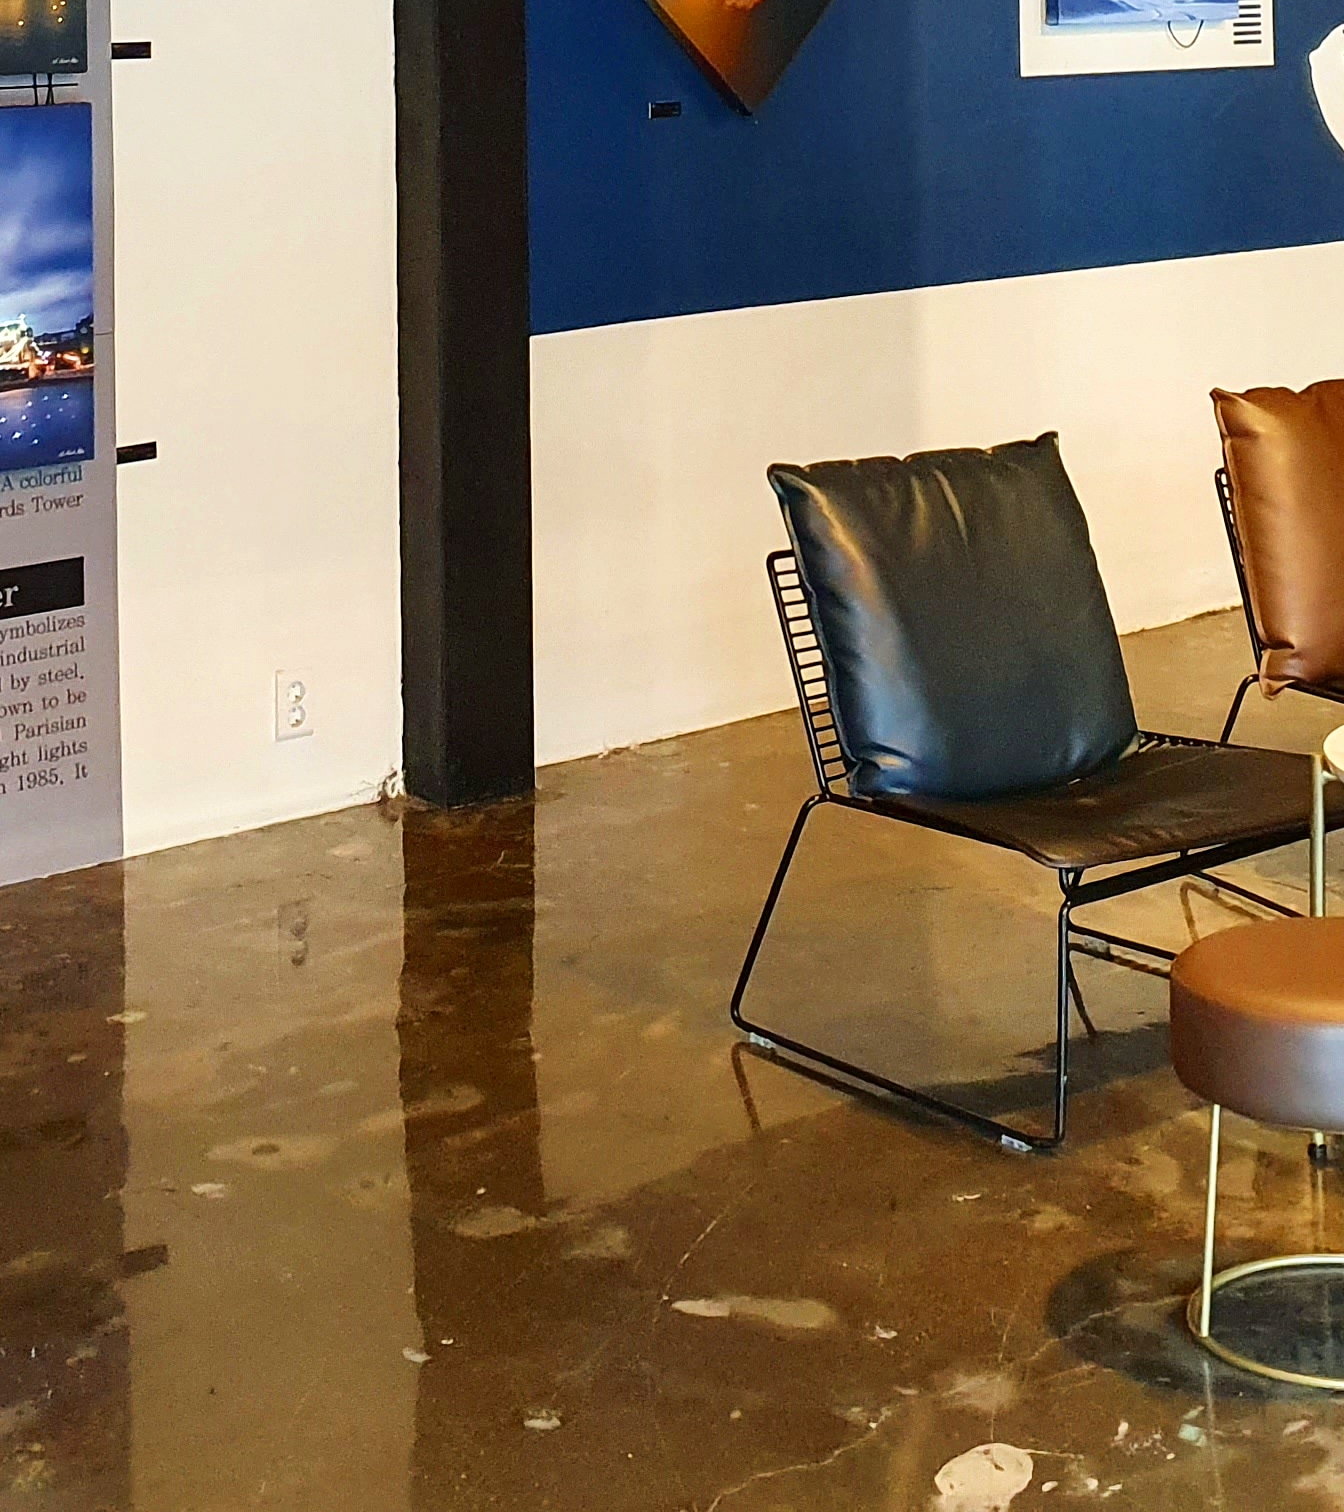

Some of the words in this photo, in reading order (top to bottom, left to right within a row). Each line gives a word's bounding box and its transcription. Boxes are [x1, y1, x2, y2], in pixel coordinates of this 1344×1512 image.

[0, 636, 85, 667] industrial
[11, 674, 29, 690] by
[42, 695, 59, 709] to
[68, 689, 86, 703] be
[14, 715, 86, 741] Parisian
[38, 740, 88, 762] lights
[75, 762, 88, 778] It
